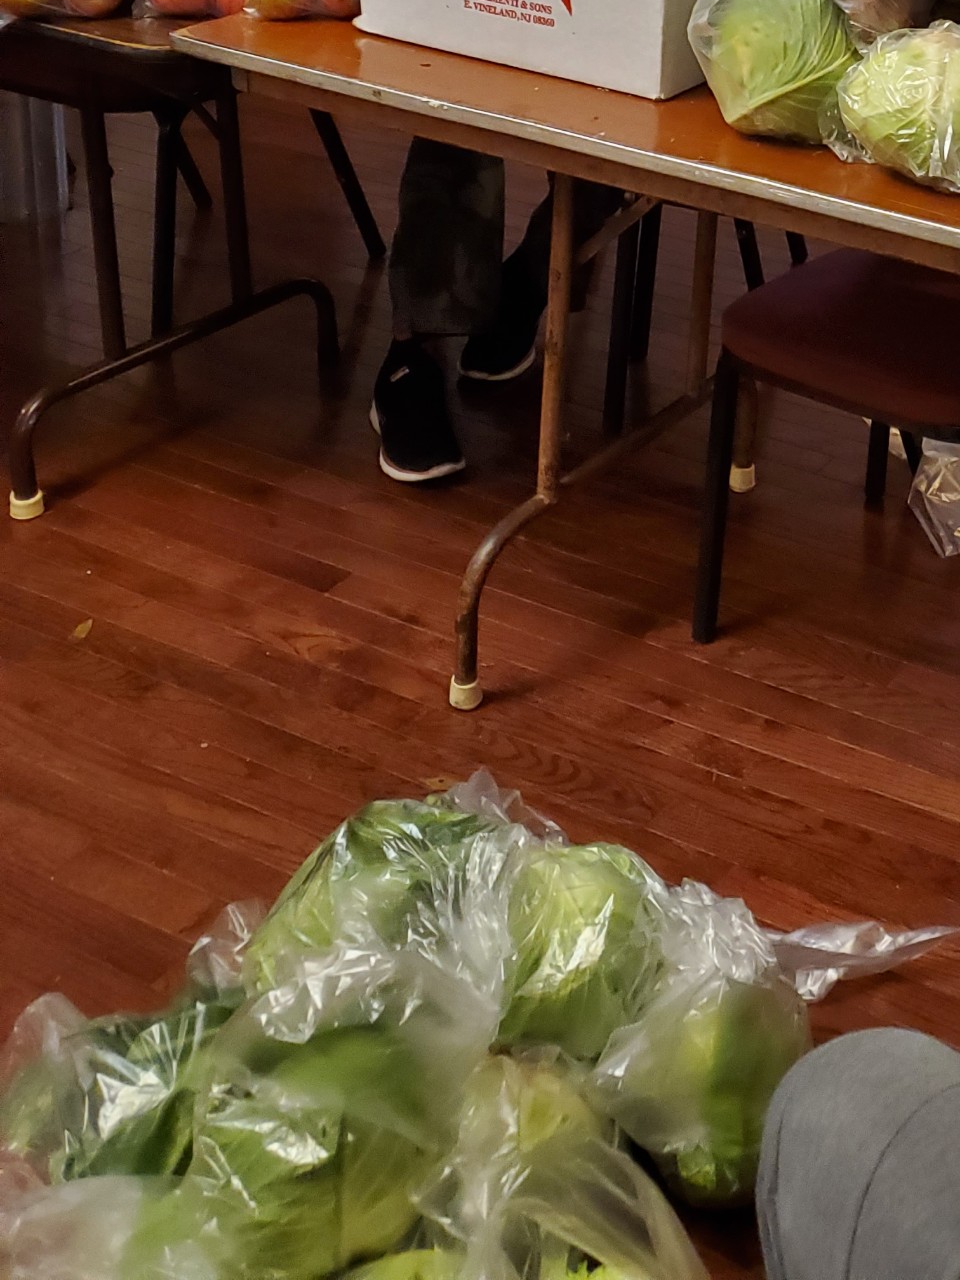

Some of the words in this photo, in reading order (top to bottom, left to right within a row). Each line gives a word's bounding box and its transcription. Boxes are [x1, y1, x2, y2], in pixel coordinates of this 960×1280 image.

[473, 3, 520, 22] VINELAND,
[520, 12, 532, 23] NJ
[533, 15, 555, 28] 08360
[521, 0, 528, 10] &
[529, 2, 552, 15] SONS
